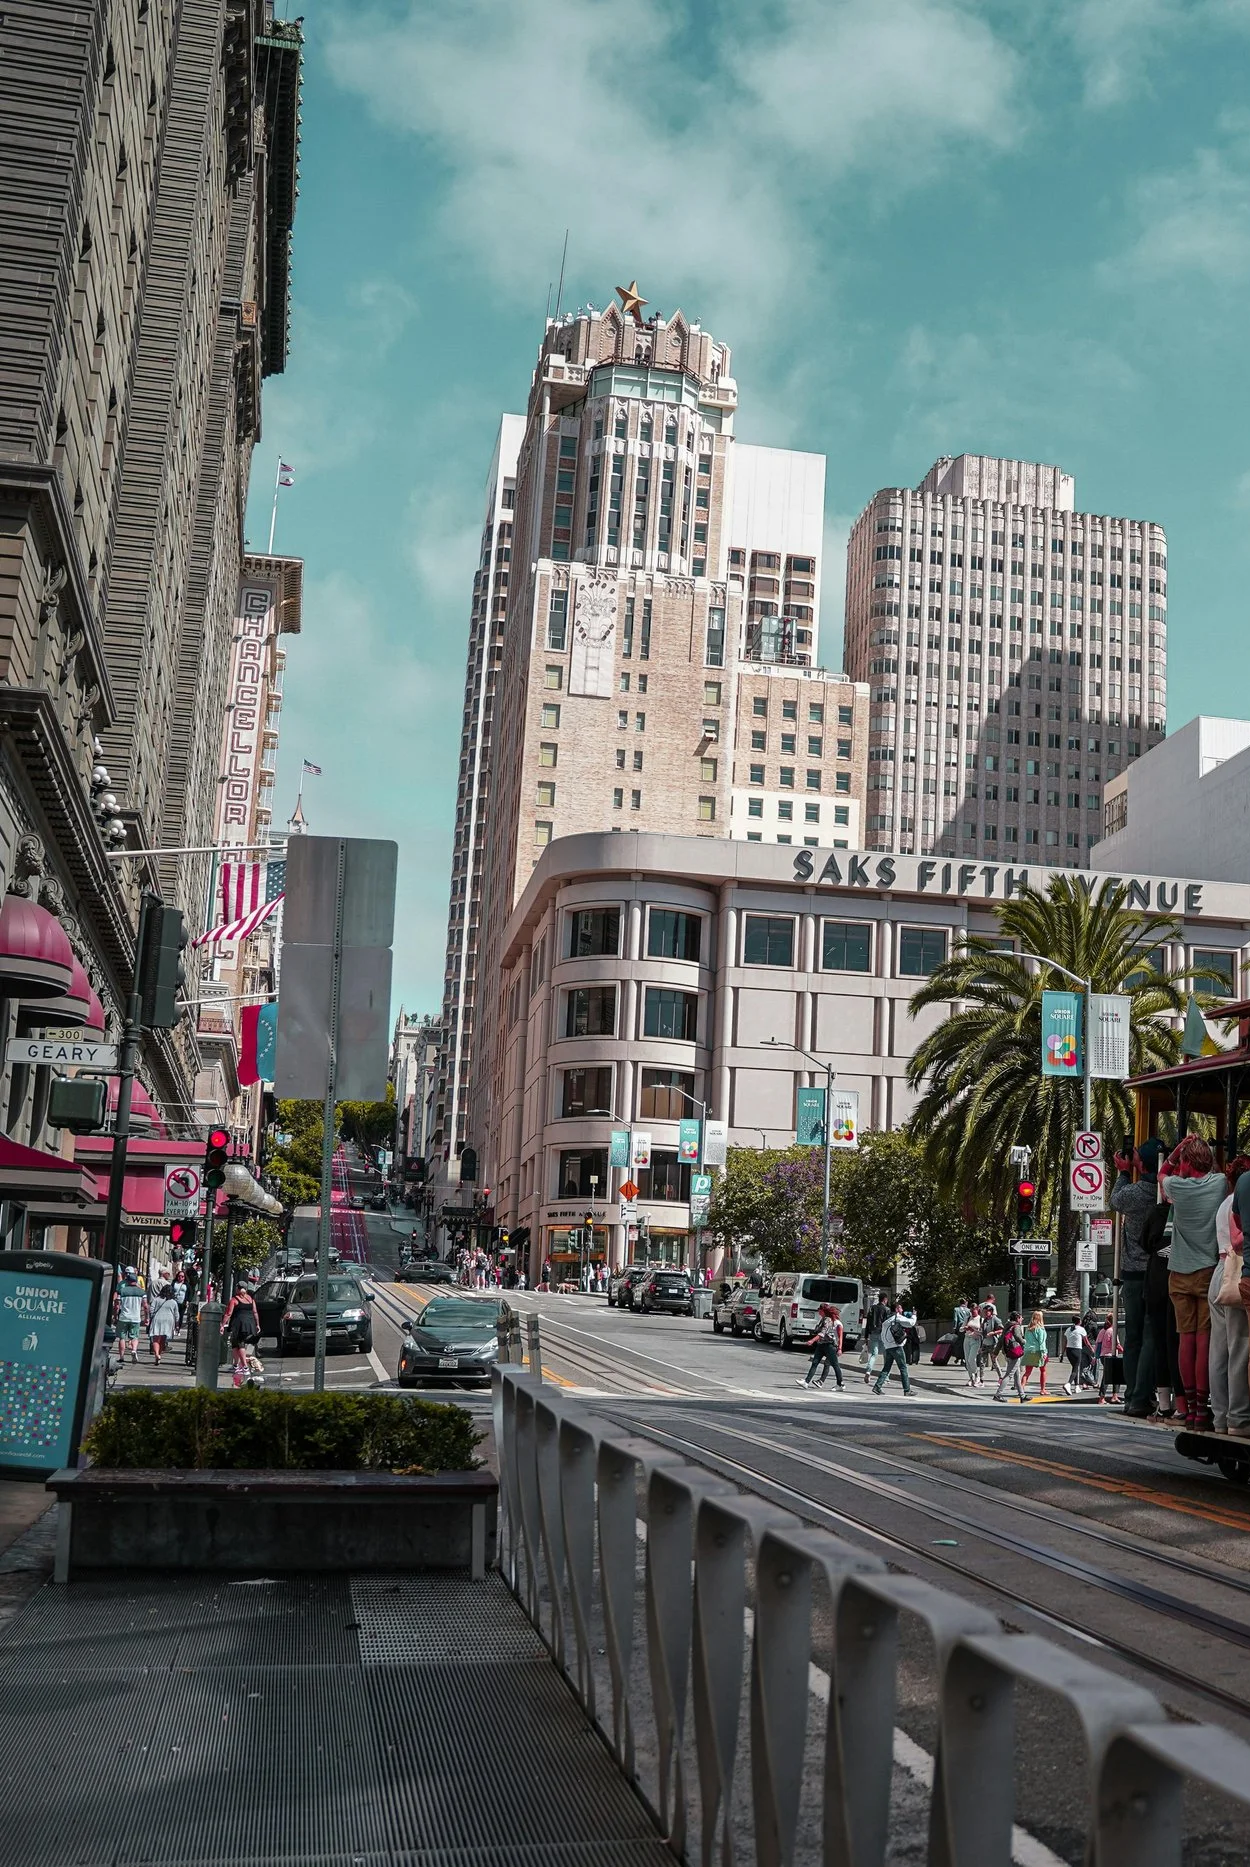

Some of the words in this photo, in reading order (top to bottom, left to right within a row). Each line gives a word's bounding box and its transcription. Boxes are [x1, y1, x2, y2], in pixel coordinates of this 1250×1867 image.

[224, 592, 269, 826] CHANCELLOR
[793, 850, 896, 888] SAKS
[918, 861, 1029, 898] FIFTH
[1050, 1013, 1074, 1022] SQUARE
[58, 1030, 80, 1040] 300
[28, 1045, 98, 1061] GEARY
[132, 1216, 162, 1225] WESTIN
[15, 1286, 59, 1299] UNION
[3, 1295, 68, 1315] SQUARE
[17, 1313, 50, 1322] ALLIANCE
